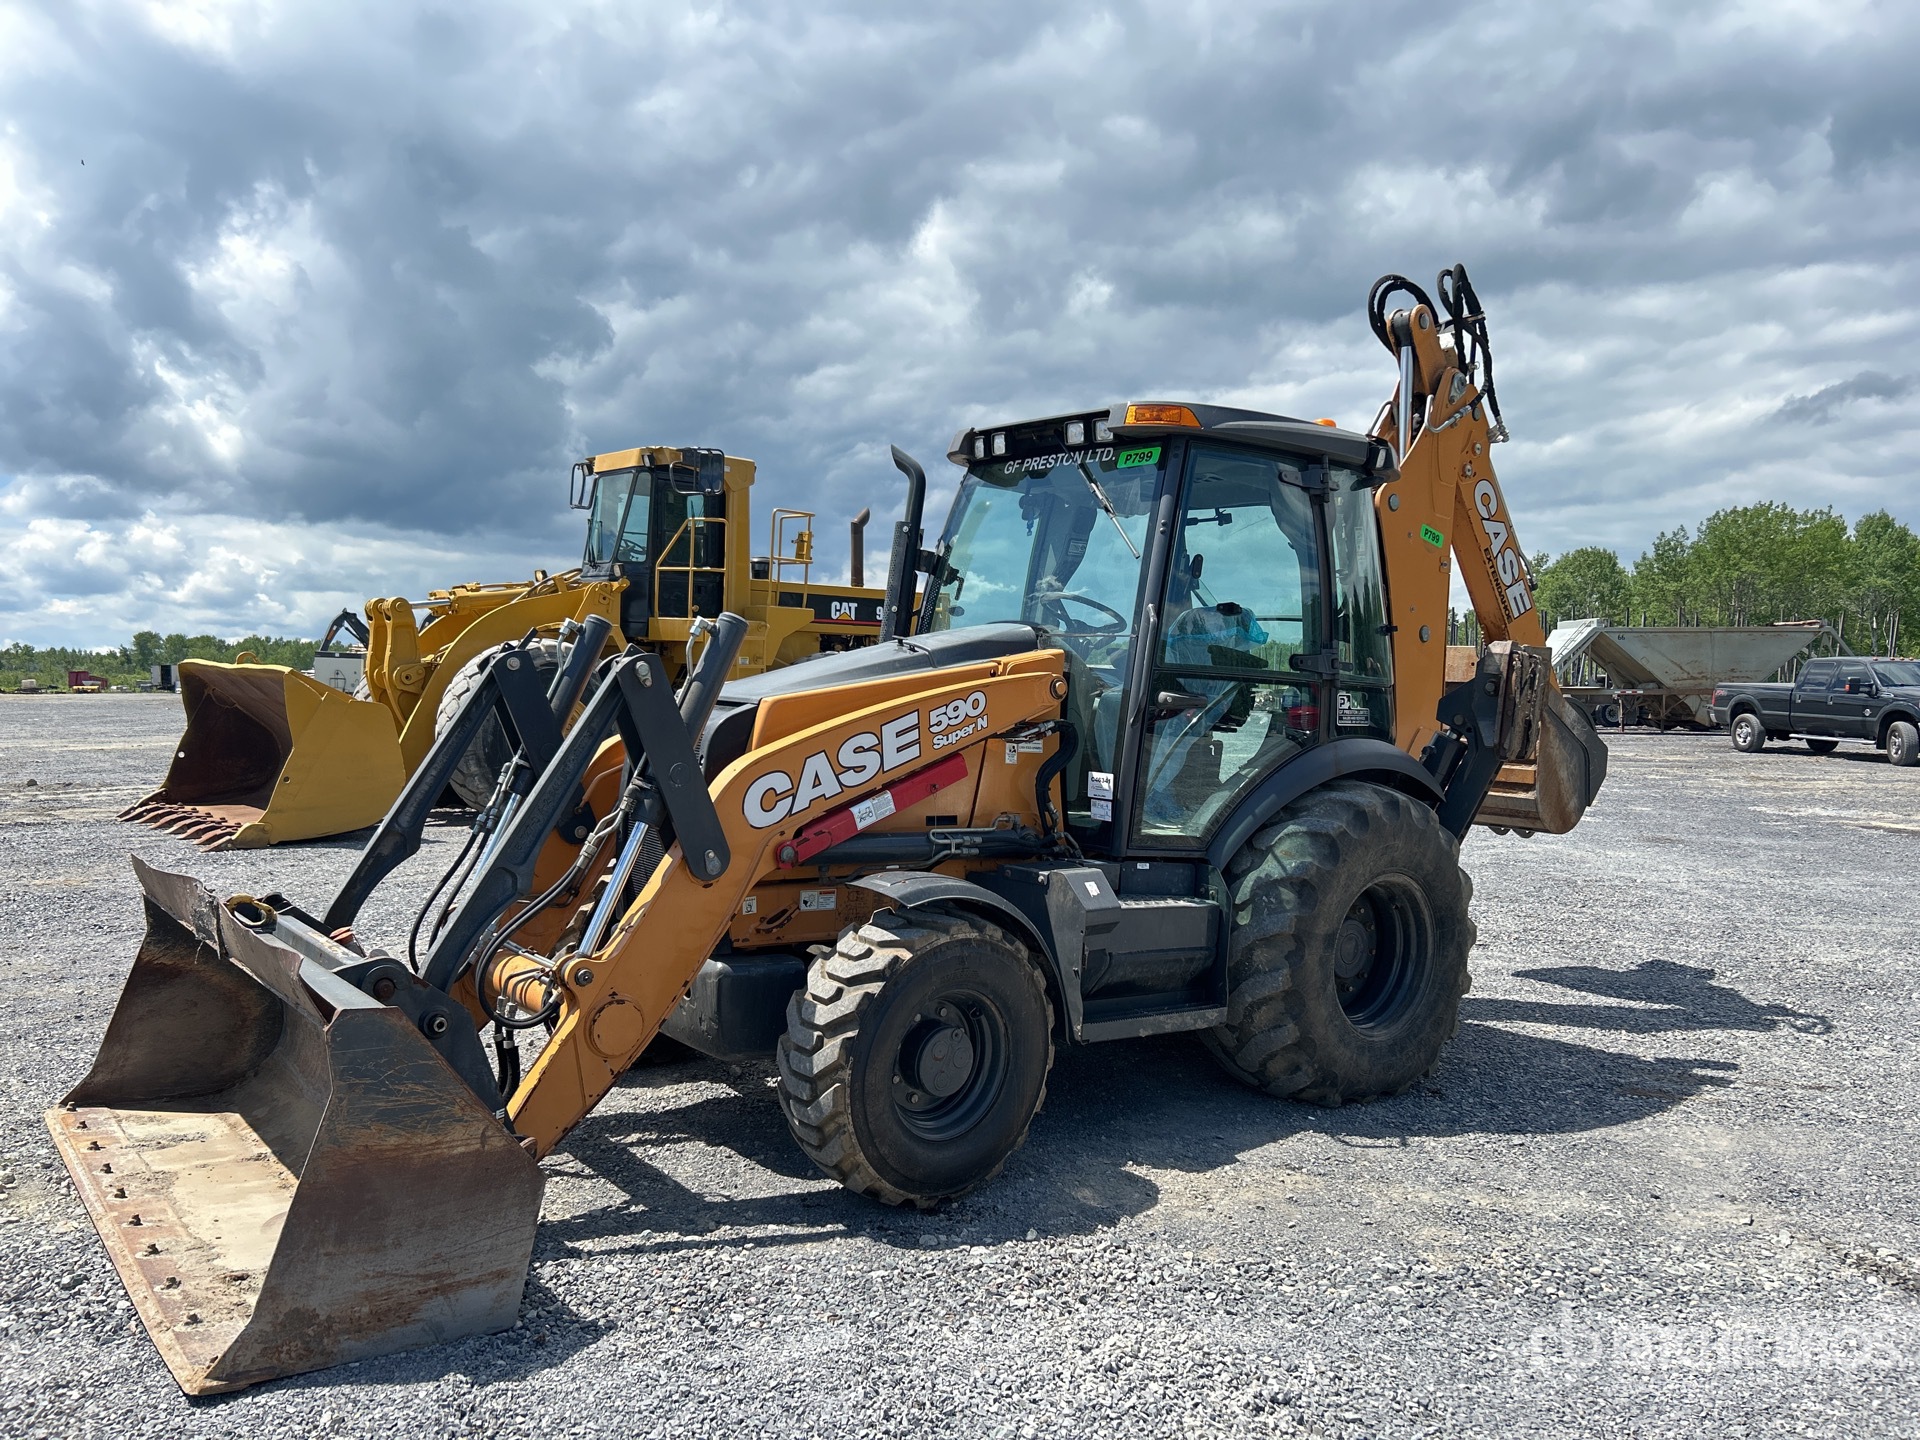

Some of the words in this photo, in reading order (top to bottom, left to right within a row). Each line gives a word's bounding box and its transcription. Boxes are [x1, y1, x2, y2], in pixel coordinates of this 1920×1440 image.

[1004, 460, 1021, 474] GF
[1085, 447, 1116, 463] LTD.
[1124, 451, 1153, 465] P799
[1423, 528, 1440, 544] P799
[1474, 478, 1533, 620] CASE
[1483, 547, 1513, 624] EXTENDAHOE
[831, 601, 858, 621] CAT
[928, 690, 987, 734] 590
[932, 725, 976, 750] Super
[976, 715, 988, 732] N
[742, 709, 921, 829] CASE
